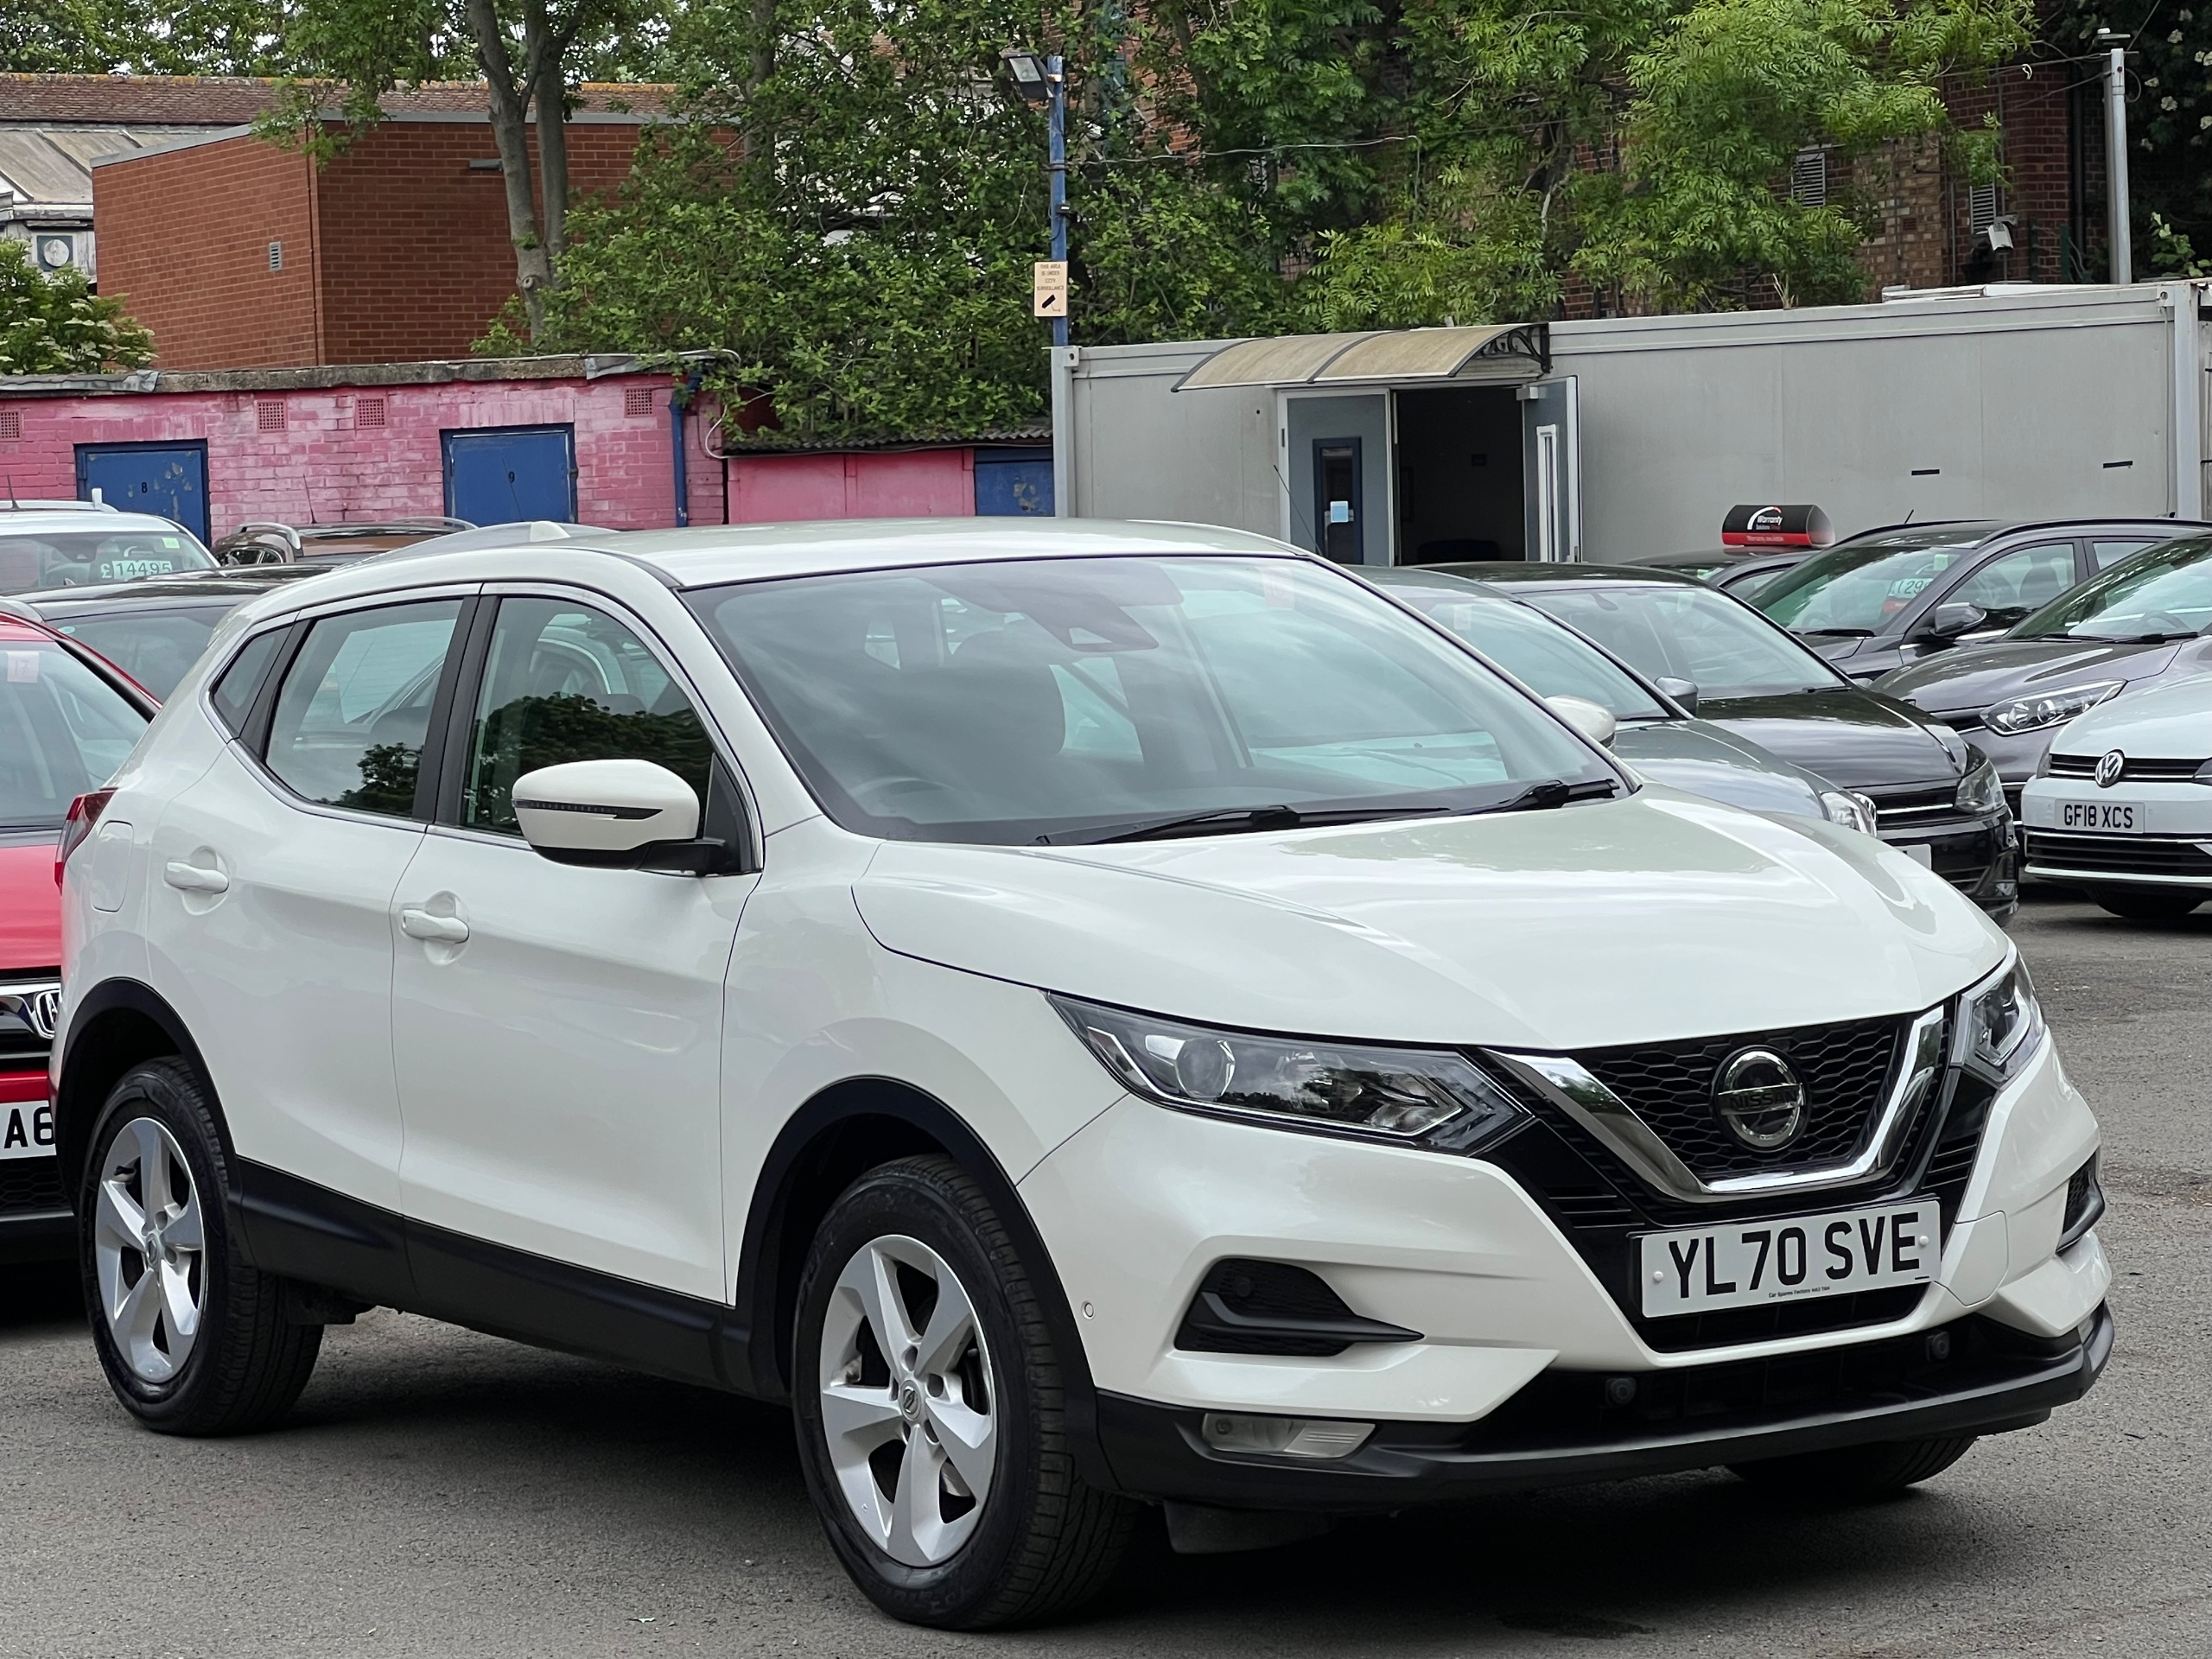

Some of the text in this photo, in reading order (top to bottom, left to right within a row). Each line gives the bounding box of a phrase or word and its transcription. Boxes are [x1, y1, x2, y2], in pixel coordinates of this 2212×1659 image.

[508, 471, 515, 483] 9
[141, 481, 148, 493] 8
[1757, 515, 1783, 525] Warranty
[2064, 804, 2133, 830] GF18 XCS
[1730, 1089, 1797, 1109] NISSAN
[1669, 1211, 1920, 1299] YL70 SVE
